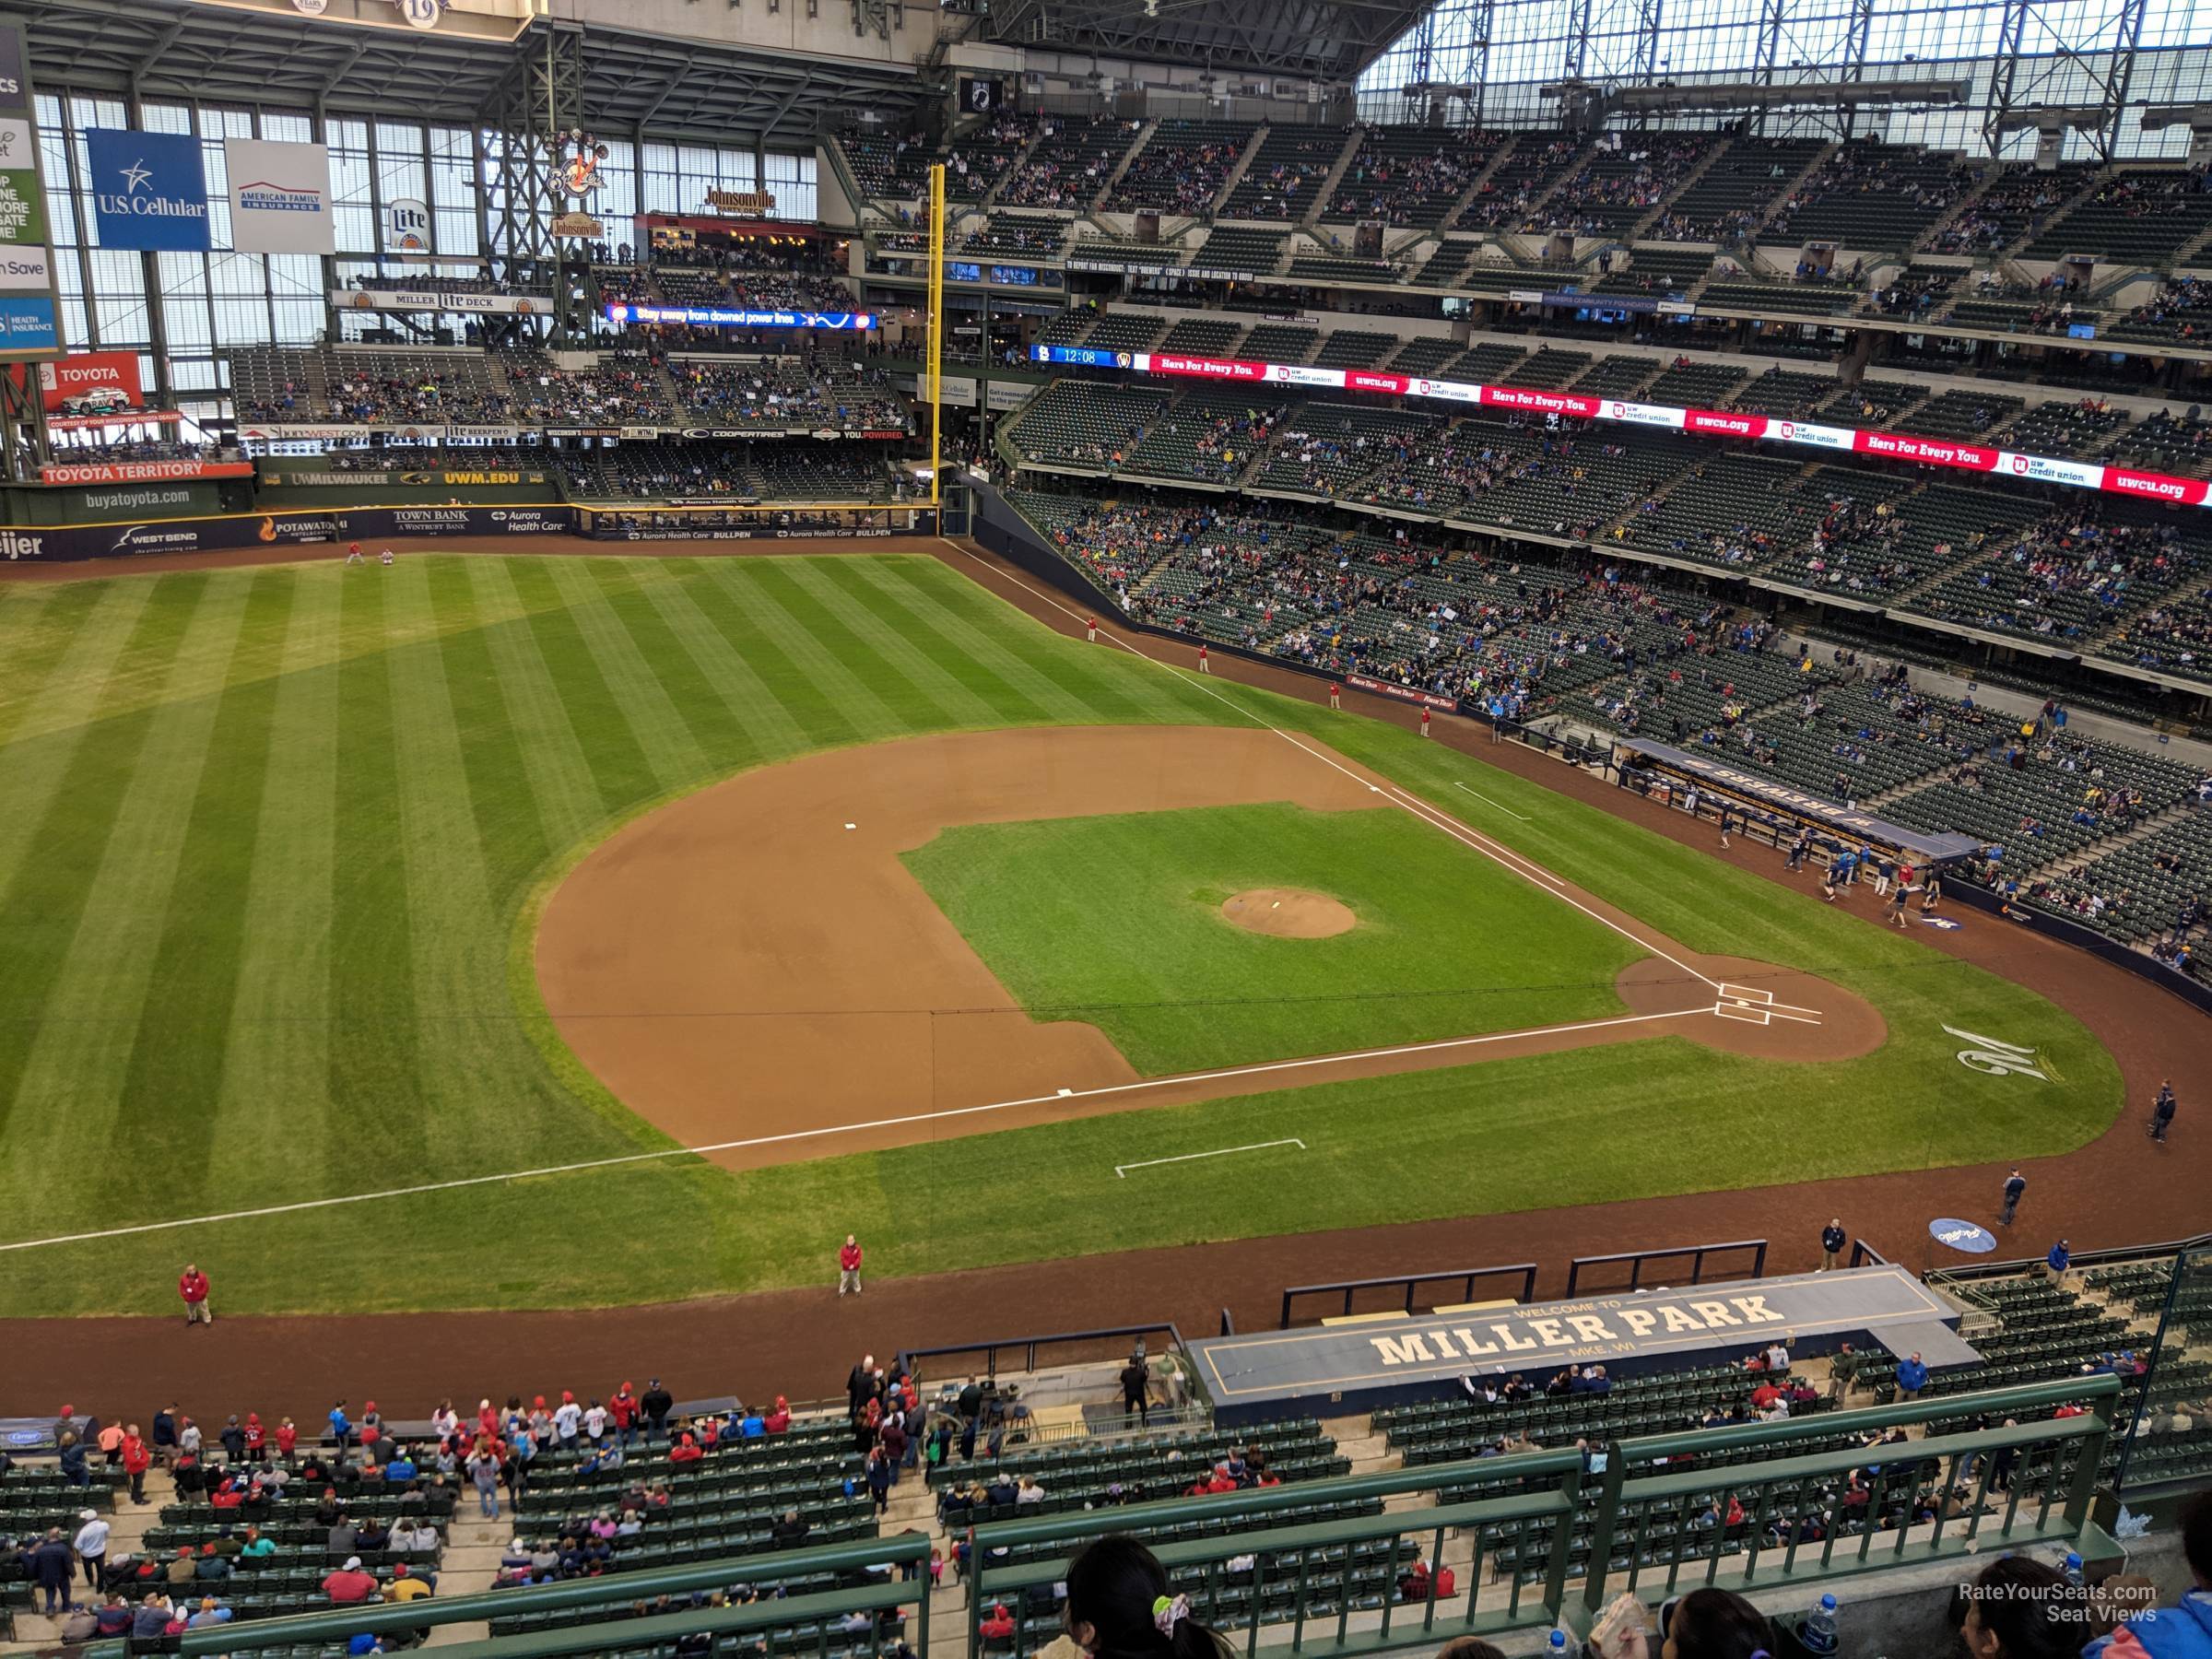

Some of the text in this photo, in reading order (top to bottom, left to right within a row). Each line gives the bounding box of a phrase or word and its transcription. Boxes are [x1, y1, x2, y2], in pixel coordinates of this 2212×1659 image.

[241, 192, 320, 204] AMERICAN FAMILY
[704, 185, 776, 208] Johnsonville
[99, 194, 206, 218] U.S. Cellular
[247, 201, 314, 211] INSURANCE
[394, 209, 425, 231] Lite
[554, 221, 602, 237] Johnsonville
[8, 261, 44, 275] Save
[395, 293, 494, 310] MILLER Lite DECK
[1573, 296, 1613, 306] COMMUNITY
[1613, 299, 1657, 310] FOUNDATION
[11, 315, 39, 324] HEALTH
[637, 308, 660, 322] Stay
[662, 311, 687, 323] away
[688, 309, 709, 322] from
[711, 311, 745, 324] downed
[747, 313, 773, 325] power
[774, 312, 794, 324] lines
[12, 324, 53, 332] INSURANCE
[1065, 349, 1096, 363] 12:08
[1161, 359, 1254, 376] Here For Every You.
[60, 368, 120, 382] TOYOTA
[1291, 374, 1311, 382] credit
[1356, 375, 1397, 390] uwcu.org
[1492, 390, 1587, 411] Here For Every You.
[1626, 412, 1671, 423] credit union
[1696, 416, 1750, 433] uwcu.org
[1794, 432, 1838, 444] credit union
[1868, 436, 1982, 465] Here For Every You.
[2030, 459, 2044, 467] uw
[46, 463, 203, 482] TOYOTA TERRITORY
[444, 473, 520, 484] UWM.EDU
[2029, 466, 2085, 482] credit union
[2117, 476, 2185, 499] uwcu.org
[86, 490, 190, 510] buyatoyota.com
[394, 511, 470, 522] TOWN BANK
[509, 511, 541, 520] Aurora
[508, 522, 563, 532] Health Care
[856, 529, 891, 537] BULLPEN
[0, 531, 42, 559] ijer
[132, 533, 197, 545] WEST BEND
[1713, 769, 1845, 817] BREWERS
[1514, 1300, 1622, 1319] WELCOME TO
[1370, 1294, 1786, 1366] MILLER PARK
[1612, 1342, 1636, 1353] WI
